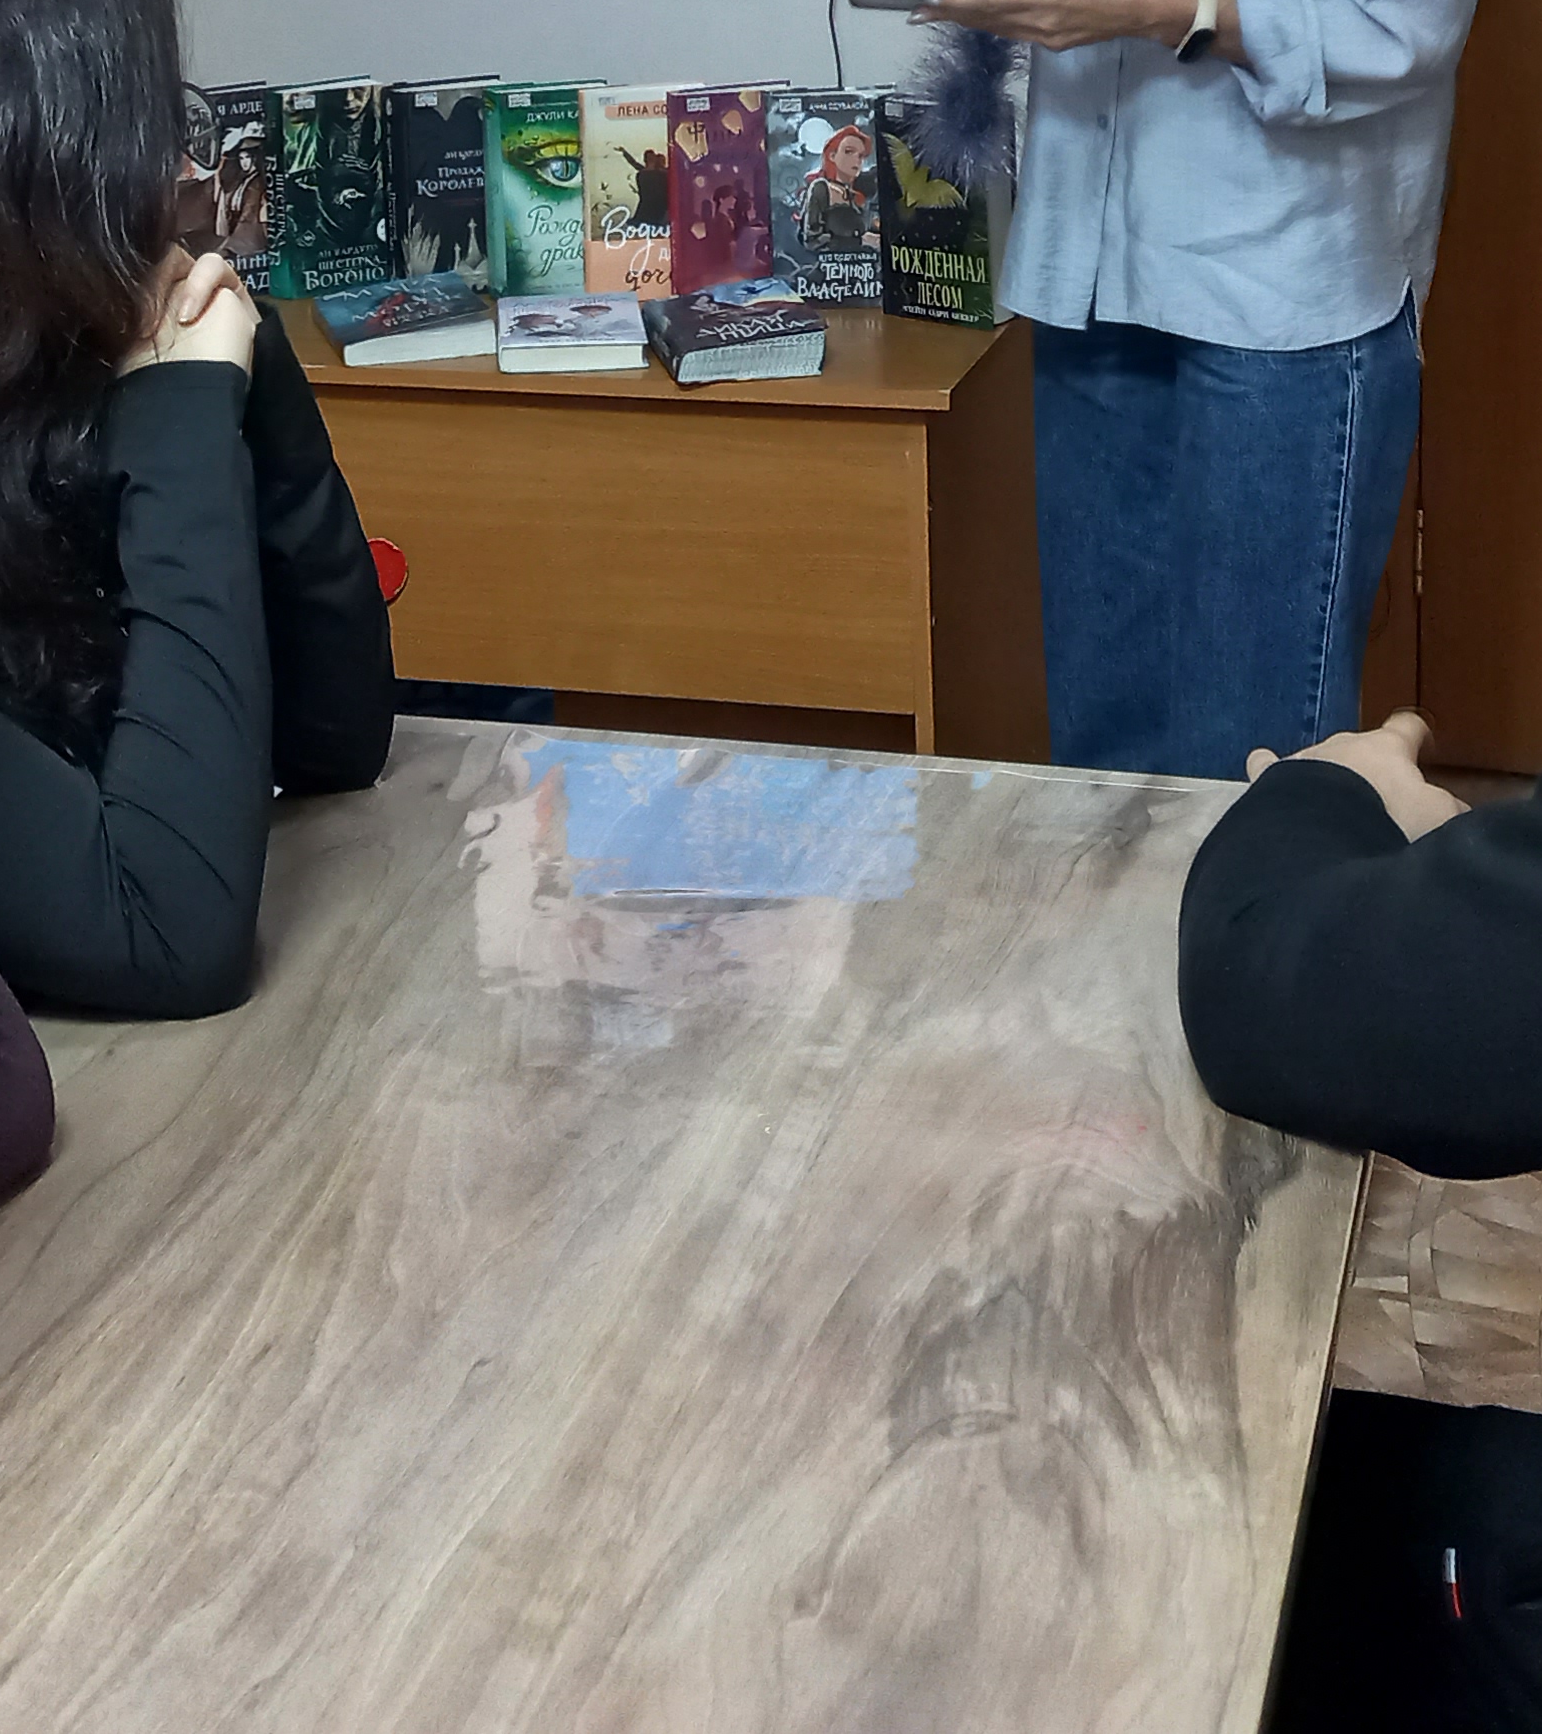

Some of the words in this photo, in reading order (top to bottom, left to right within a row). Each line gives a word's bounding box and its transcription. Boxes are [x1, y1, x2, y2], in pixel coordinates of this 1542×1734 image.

[229, 100, 264, 115] АРДЕ
[568, 109, 580, 121] КА
[617, 103, 651, 117] ЛЕНА
[653, 102, 668, 116] СО
[415, 176, 485, 197] КОРОЛЕВ
[303, 266, 385, 292] ВОРОНО
[915, 280, 965, 310] ЛЕСОМ
